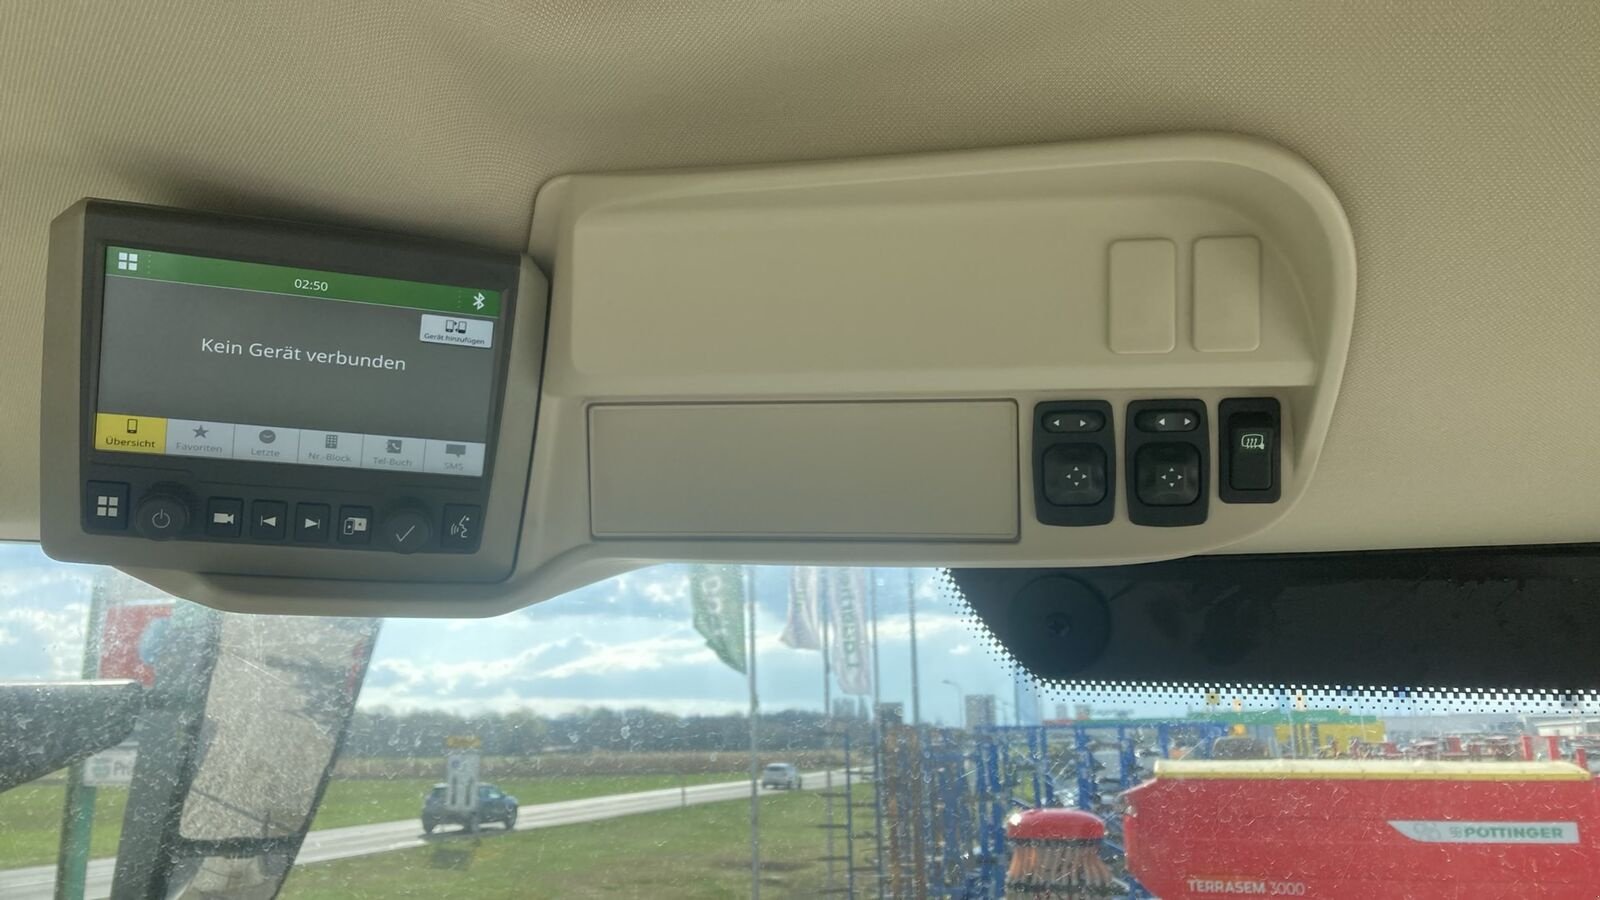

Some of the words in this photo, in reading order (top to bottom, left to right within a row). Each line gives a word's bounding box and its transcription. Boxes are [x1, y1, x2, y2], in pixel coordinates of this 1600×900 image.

[294, 278, 329, 292] 02:50
[424, 333, 444, 341] Gerät
[446, 335, 485, 345] hinzufügen
[201, 337, 243, 355] Kein
[249, 343, 302, 361] Gerät
[306, 350, 406, 371] verbunden
[105, 435, 156, 449] Übersicht
[175, 441, 223, 454] Favoriten
[250, 447, 281, 458] Letzte
[373, 456, 413, 467] Tel-Buch
[443, 462, 465, 471] SMS
[1187, 879, 1267, 894] TERRASEM
[1269, 881, 1306, 897] 3000
